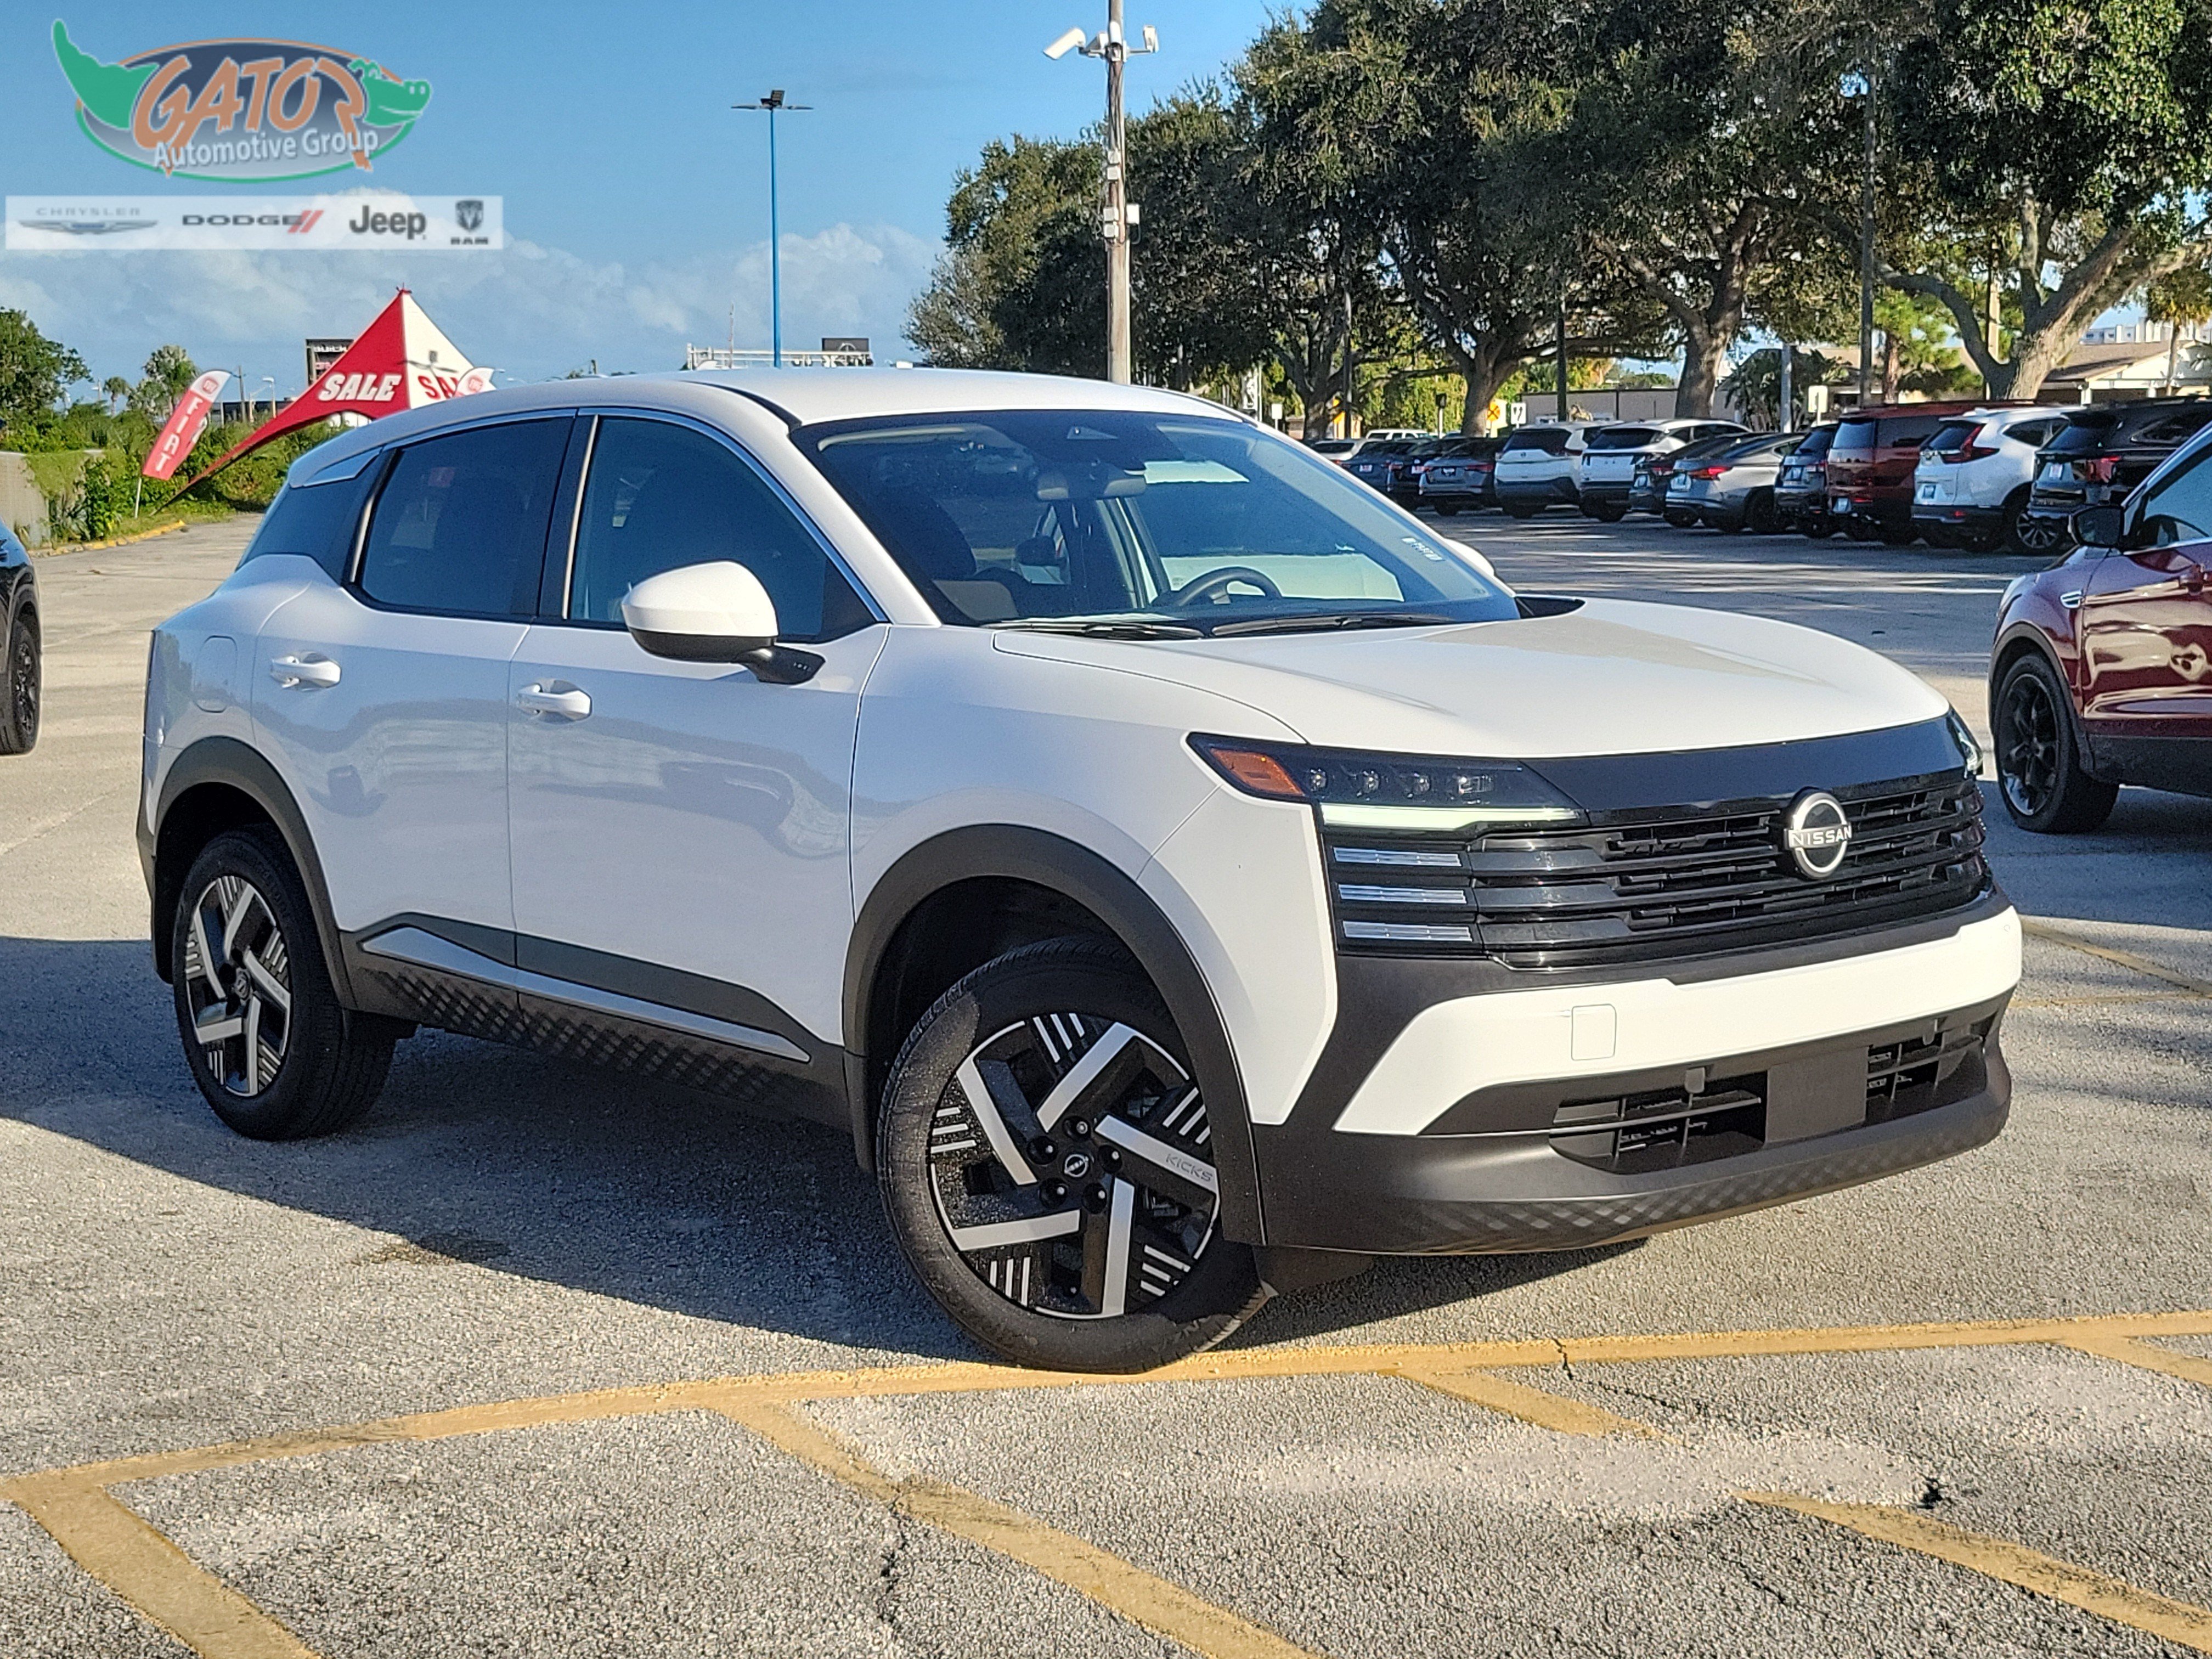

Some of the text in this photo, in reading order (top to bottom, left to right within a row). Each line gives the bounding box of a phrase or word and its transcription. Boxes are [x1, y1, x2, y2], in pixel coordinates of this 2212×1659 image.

[318, 374, 402, 401] SALE
[155, 396, 204, 472] FIAT
[1792, 825, 1852, 845] NISSAN
[1166, 1153, 1213, 1182] KICKS
